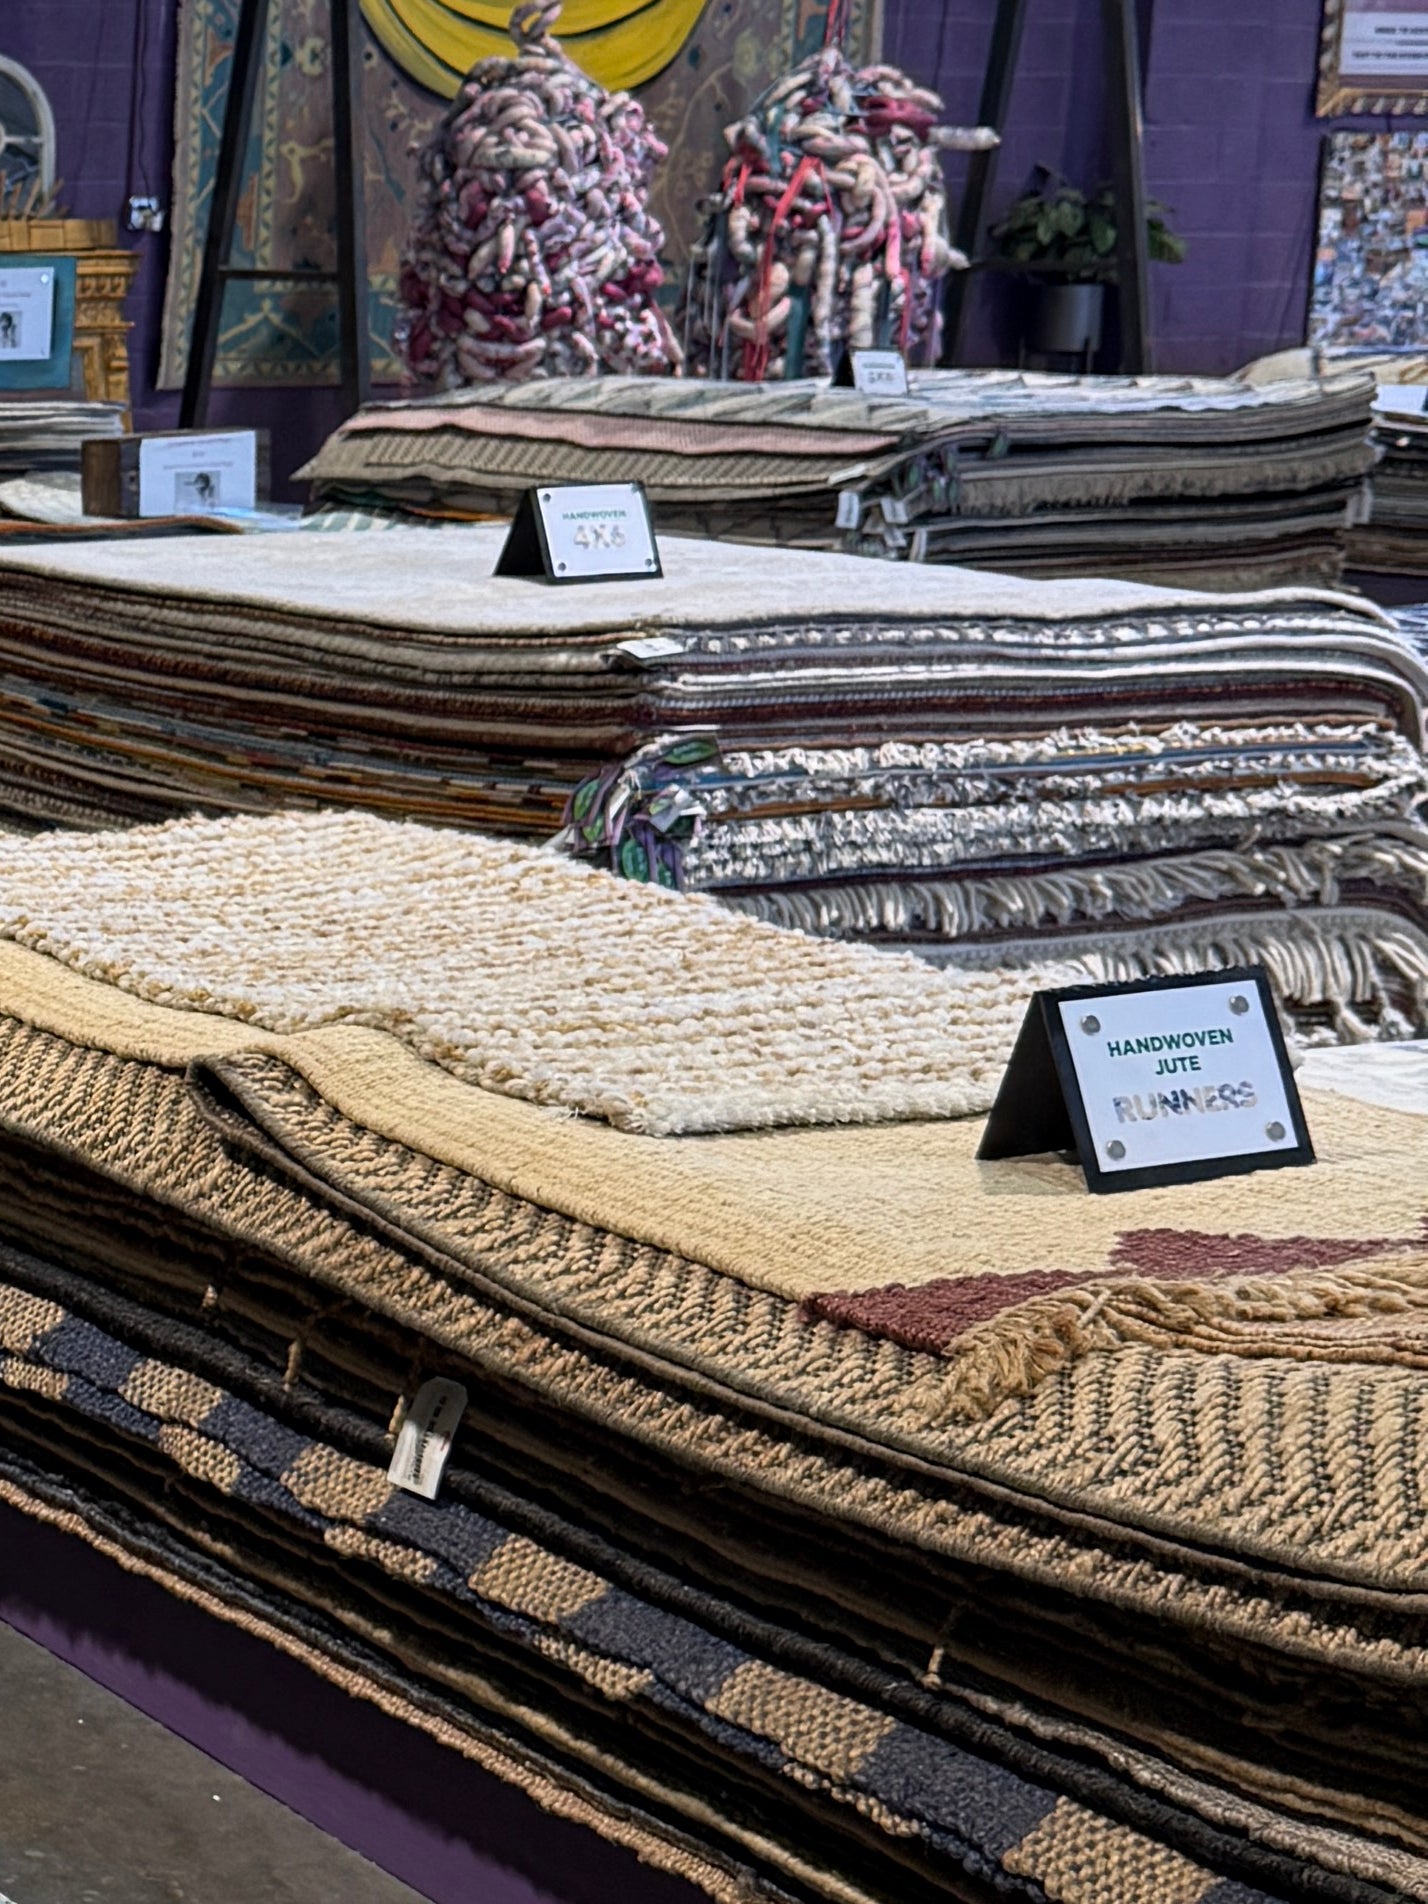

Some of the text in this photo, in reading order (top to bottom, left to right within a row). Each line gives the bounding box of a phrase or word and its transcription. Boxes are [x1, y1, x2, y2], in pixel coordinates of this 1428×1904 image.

[562, 509, 627, 520] HANDWOVEN
[573, 524, 626, 550] 4X6
[1107, 1028, 1234, 1057] HANDWOVEN
[1155, 1055, 1201, 1076] JUTE
[1112, 1080, 1258, 1124] RUNNERS
